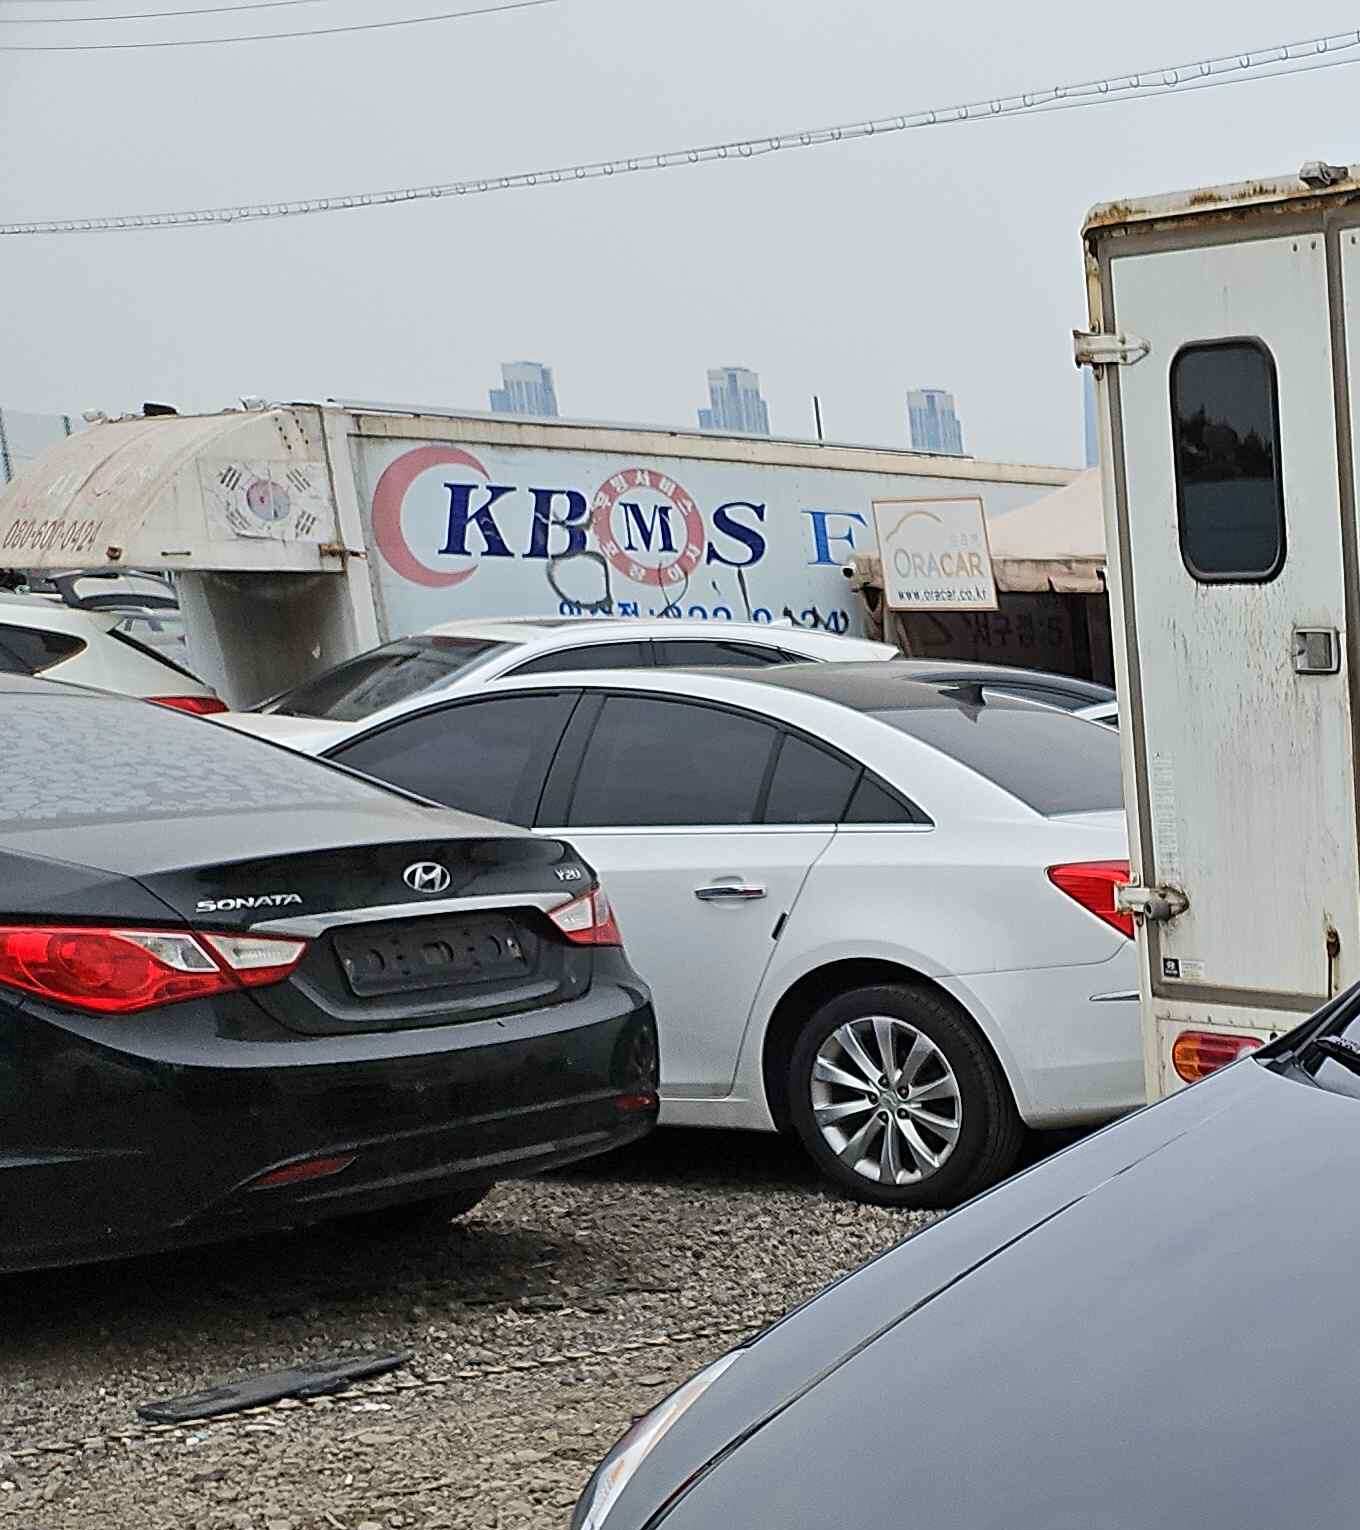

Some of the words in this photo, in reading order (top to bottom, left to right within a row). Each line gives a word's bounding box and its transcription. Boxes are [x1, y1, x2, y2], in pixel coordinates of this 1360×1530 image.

[893, 547, 985, 579] ORACAR
[896, 586, 989, 602] www.oracar.co.kr
[195, 893, 303, 914] SONATA
